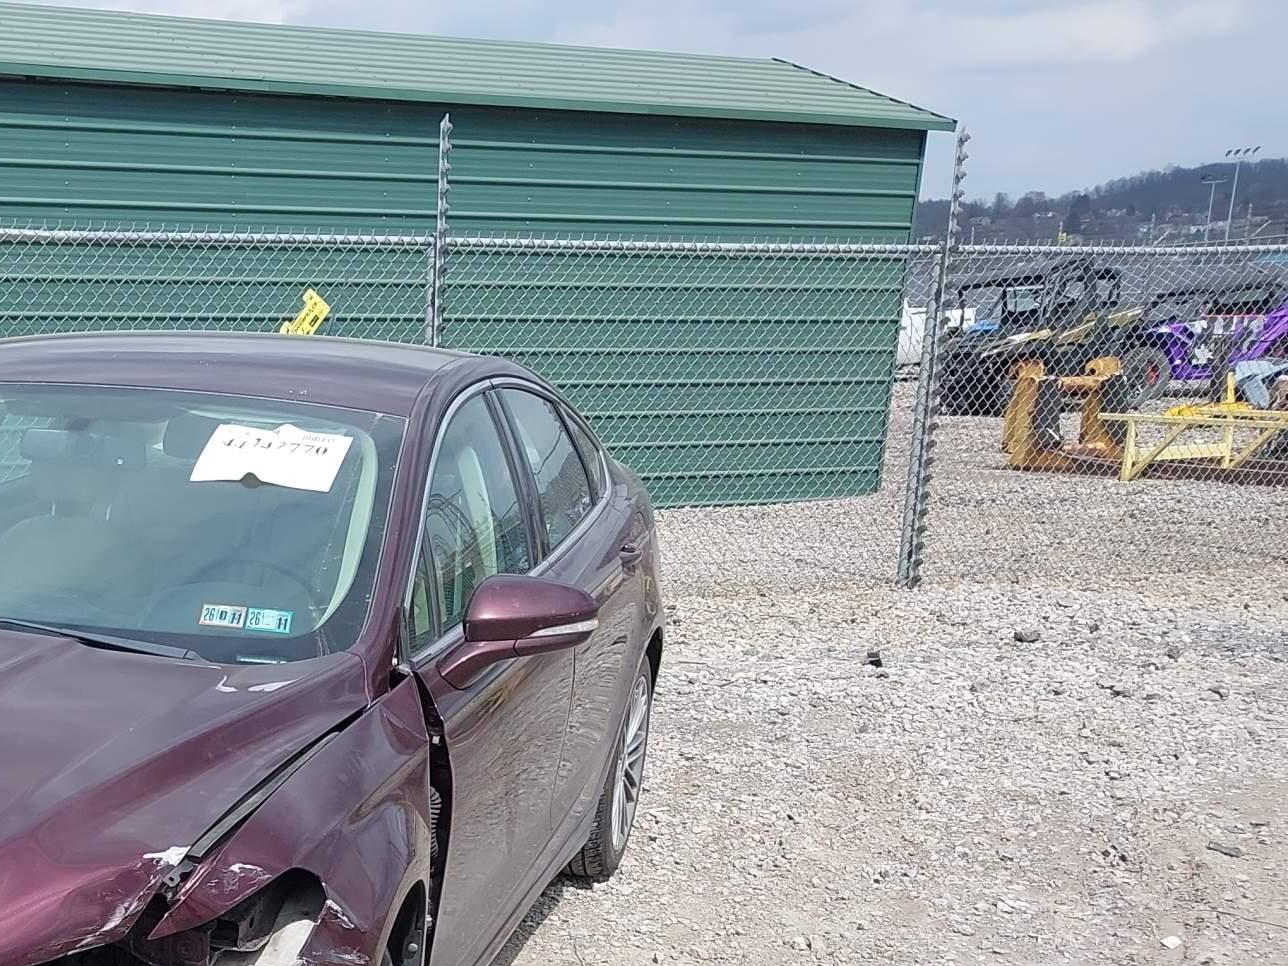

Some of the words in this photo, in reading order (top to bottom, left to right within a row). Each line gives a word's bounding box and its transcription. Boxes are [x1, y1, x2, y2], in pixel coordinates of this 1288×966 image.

[204, 607, 216, 622] 26
[230, 612, 242, 625] 11
[250, 611, 262, 625] 26
[276, 617, 288, 630] 11
